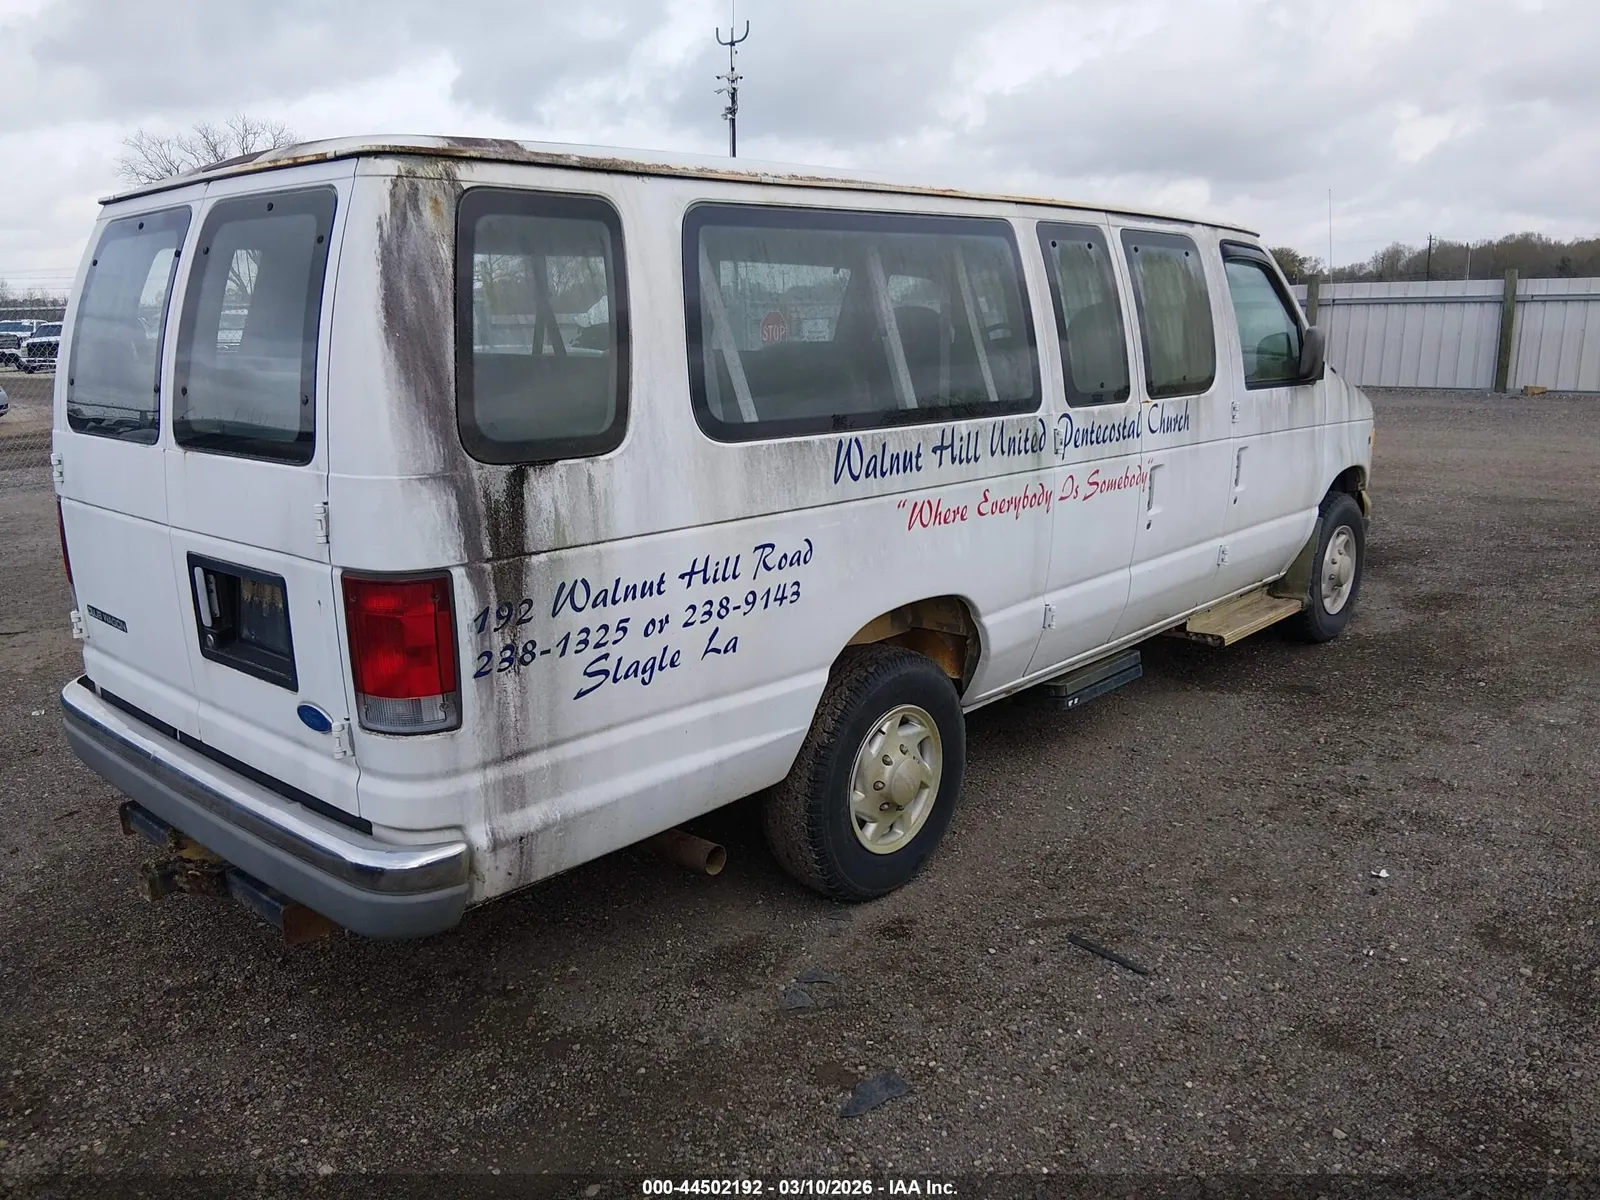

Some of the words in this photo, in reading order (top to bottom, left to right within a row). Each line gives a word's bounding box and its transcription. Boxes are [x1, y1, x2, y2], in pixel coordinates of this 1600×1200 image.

[762, 325, 785, 341] STOP
[833, 438, 923, 485] Walnut
[931, 423, 981, 467] Hill
[989, 418, 1047, 457] United
[1057, 412, 1142, 461] Pentecostal
[1147, 401, 1191, 435] Church
[976, 488, 1052, 520] Everybody
[1058, 474, 1080, 502] Is
[473, 599, 534, 634] 192
[551, 572, 665, 617] Walnut
[678, 554, 741, 589] Hill
[752, 538, 814, 580] Road
[473, 617, 631, 679] 238-1325
[643, 613, 670, 637] or
[682, 581, 801, 629] 238-9143
[573, 649, 682, 700] Slagle
[701, 626, 739, 661] La
